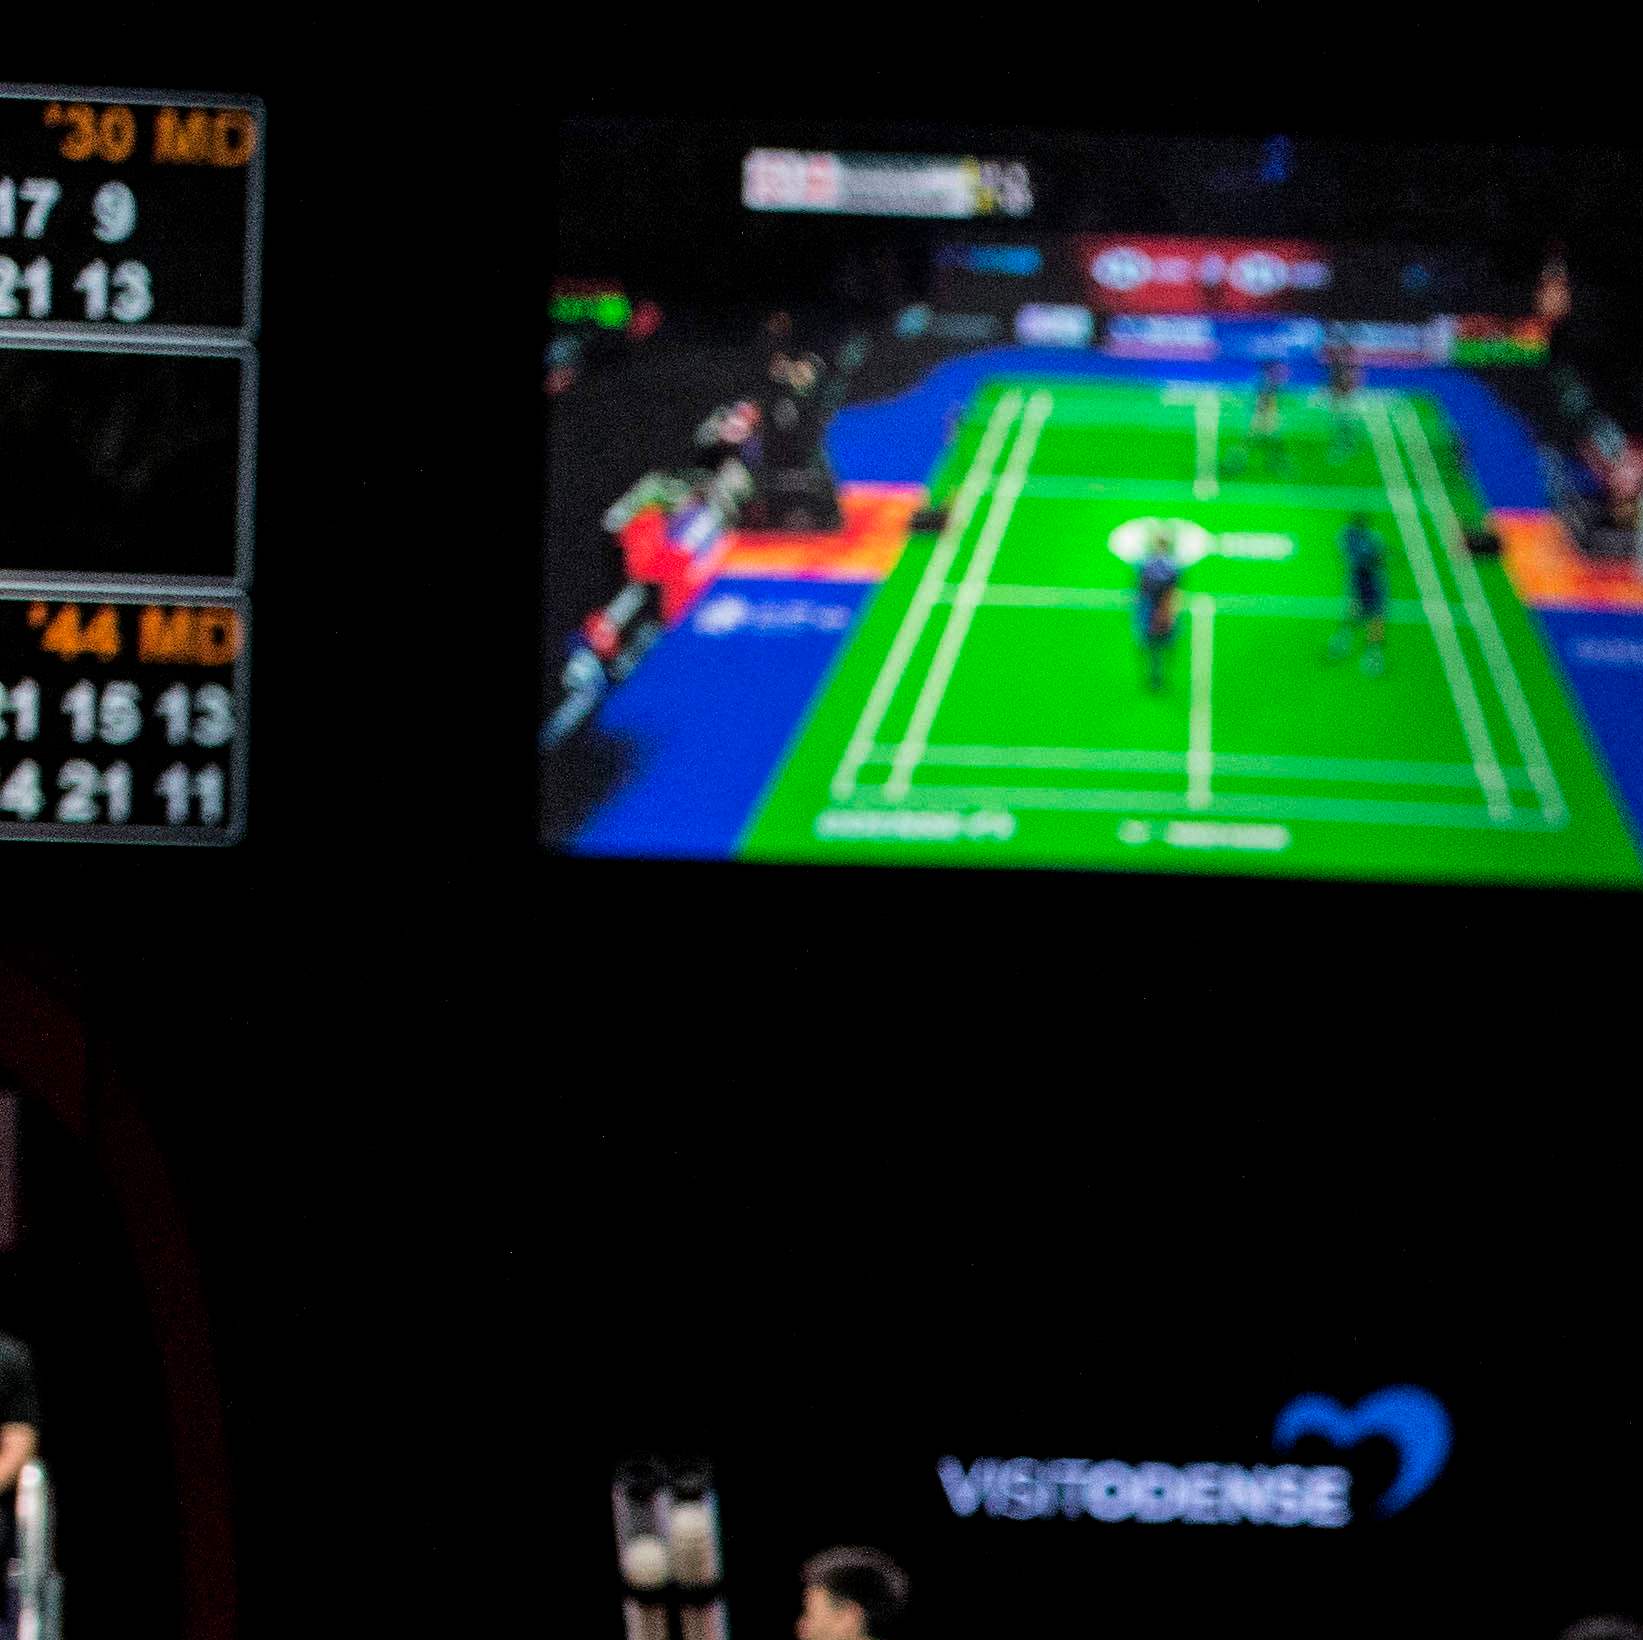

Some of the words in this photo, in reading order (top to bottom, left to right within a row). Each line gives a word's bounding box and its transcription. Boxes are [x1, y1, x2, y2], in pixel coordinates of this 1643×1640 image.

[93, 180, 139, 244] 9
[72, 257, 154, 323] 13
[154, 681, 235, 748] 13
[55, 757, 134, 824] 21
[154, 760, 224, 825] 11
